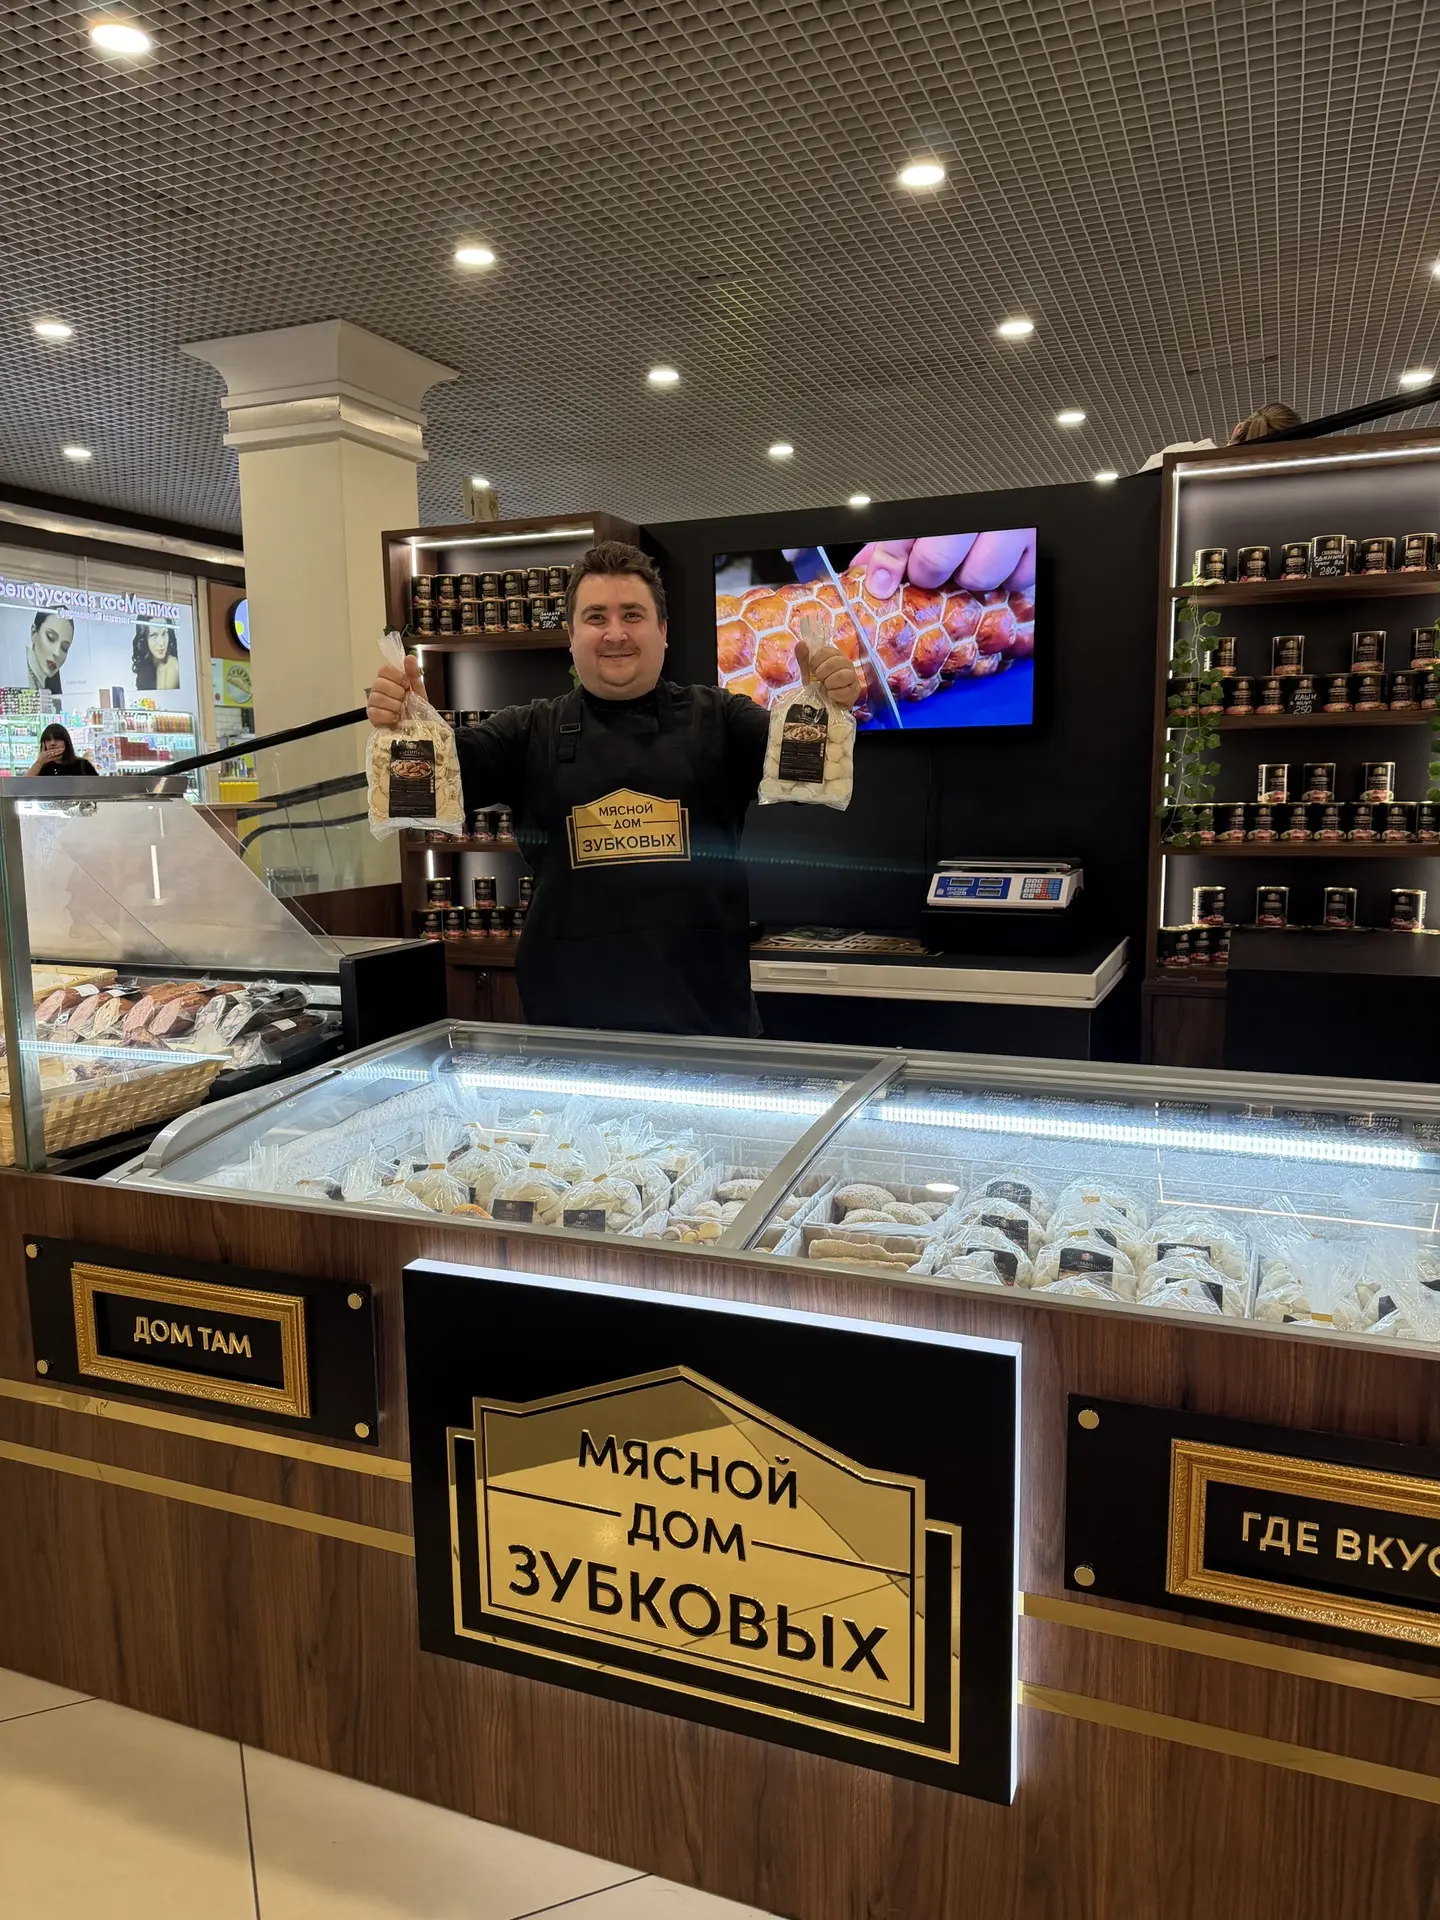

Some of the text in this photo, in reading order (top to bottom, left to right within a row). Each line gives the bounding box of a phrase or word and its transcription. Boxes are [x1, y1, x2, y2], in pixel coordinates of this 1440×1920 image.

[598, 802, 653, 817] МЯСНОЙ
[613, 818, 641, 829] ДОМ
[582, 834, 676, 852] ЗУБКОВЫХ
[133, 1316, 252, 1358] ДОМ ТАМ
[578, 1429, 800, 1509] МЯСНОЙ
[627, 1503, 747, 1562] ДОМ
[1241, 1511, 1320, 1556] ГДЕ
[508, 1544, 890, 1682] ЗУБКОВЫХ
